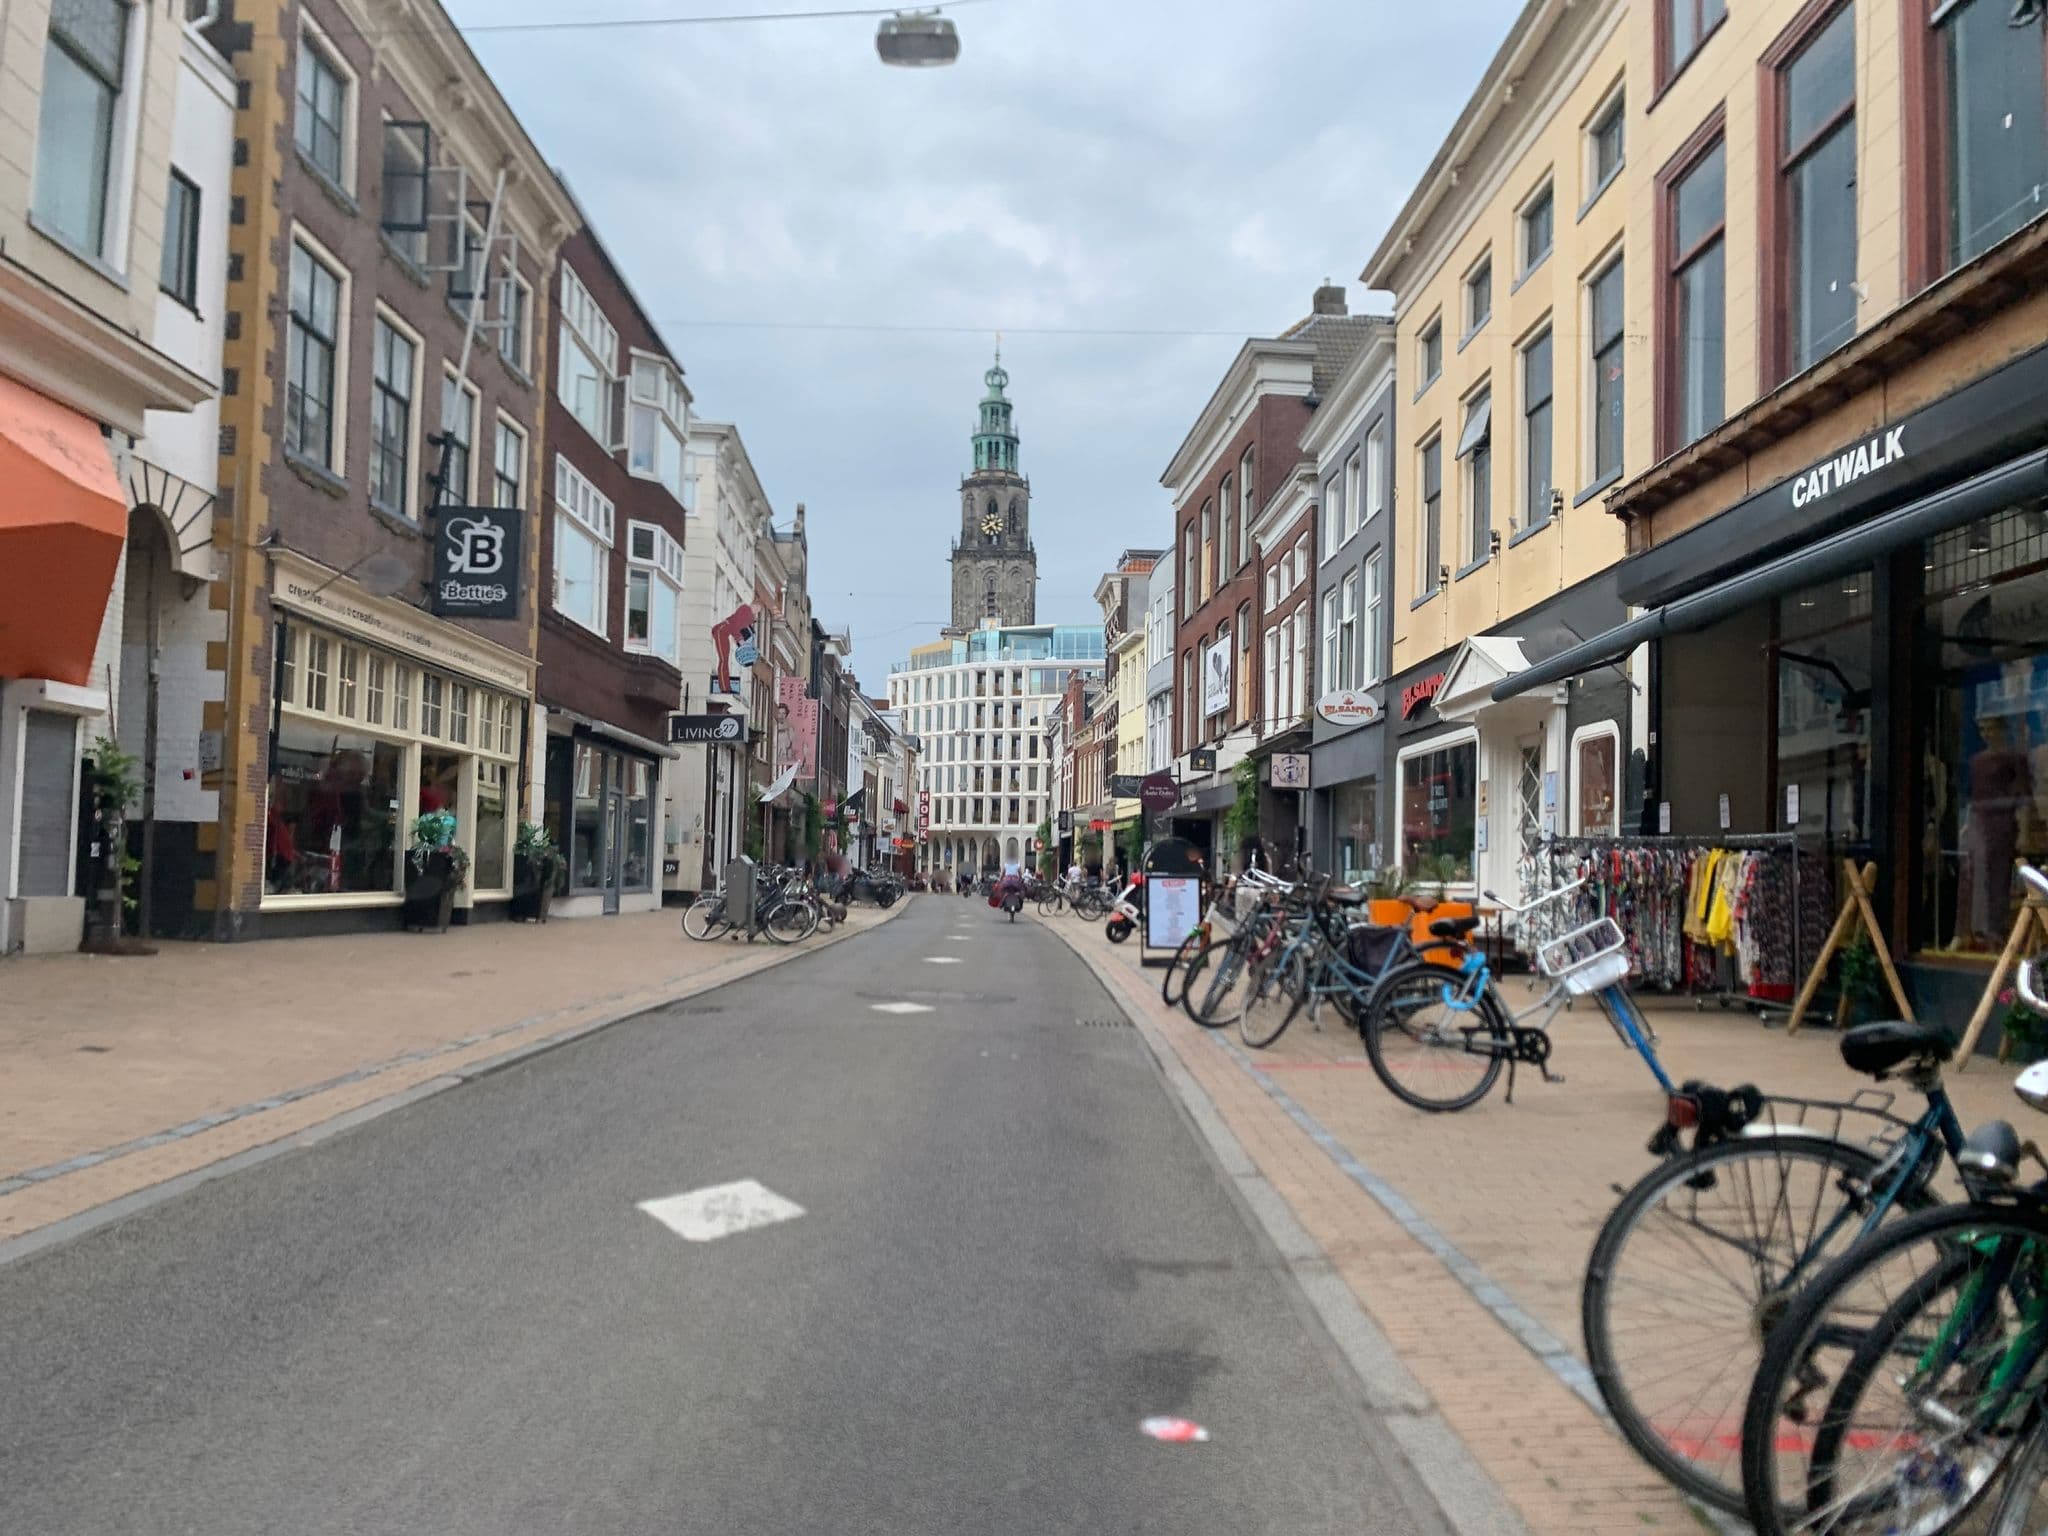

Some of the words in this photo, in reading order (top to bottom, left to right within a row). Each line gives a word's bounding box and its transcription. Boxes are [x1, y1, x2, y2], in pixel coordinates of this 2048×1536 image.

[1792, 424, 1906, 508] CATWALK
[446, 583, 506, 601] Betties
[677, 727, 723, 739] LIVING
[723, 723, 735, 732] 27
[920, 792, 929, 839] HOEK
